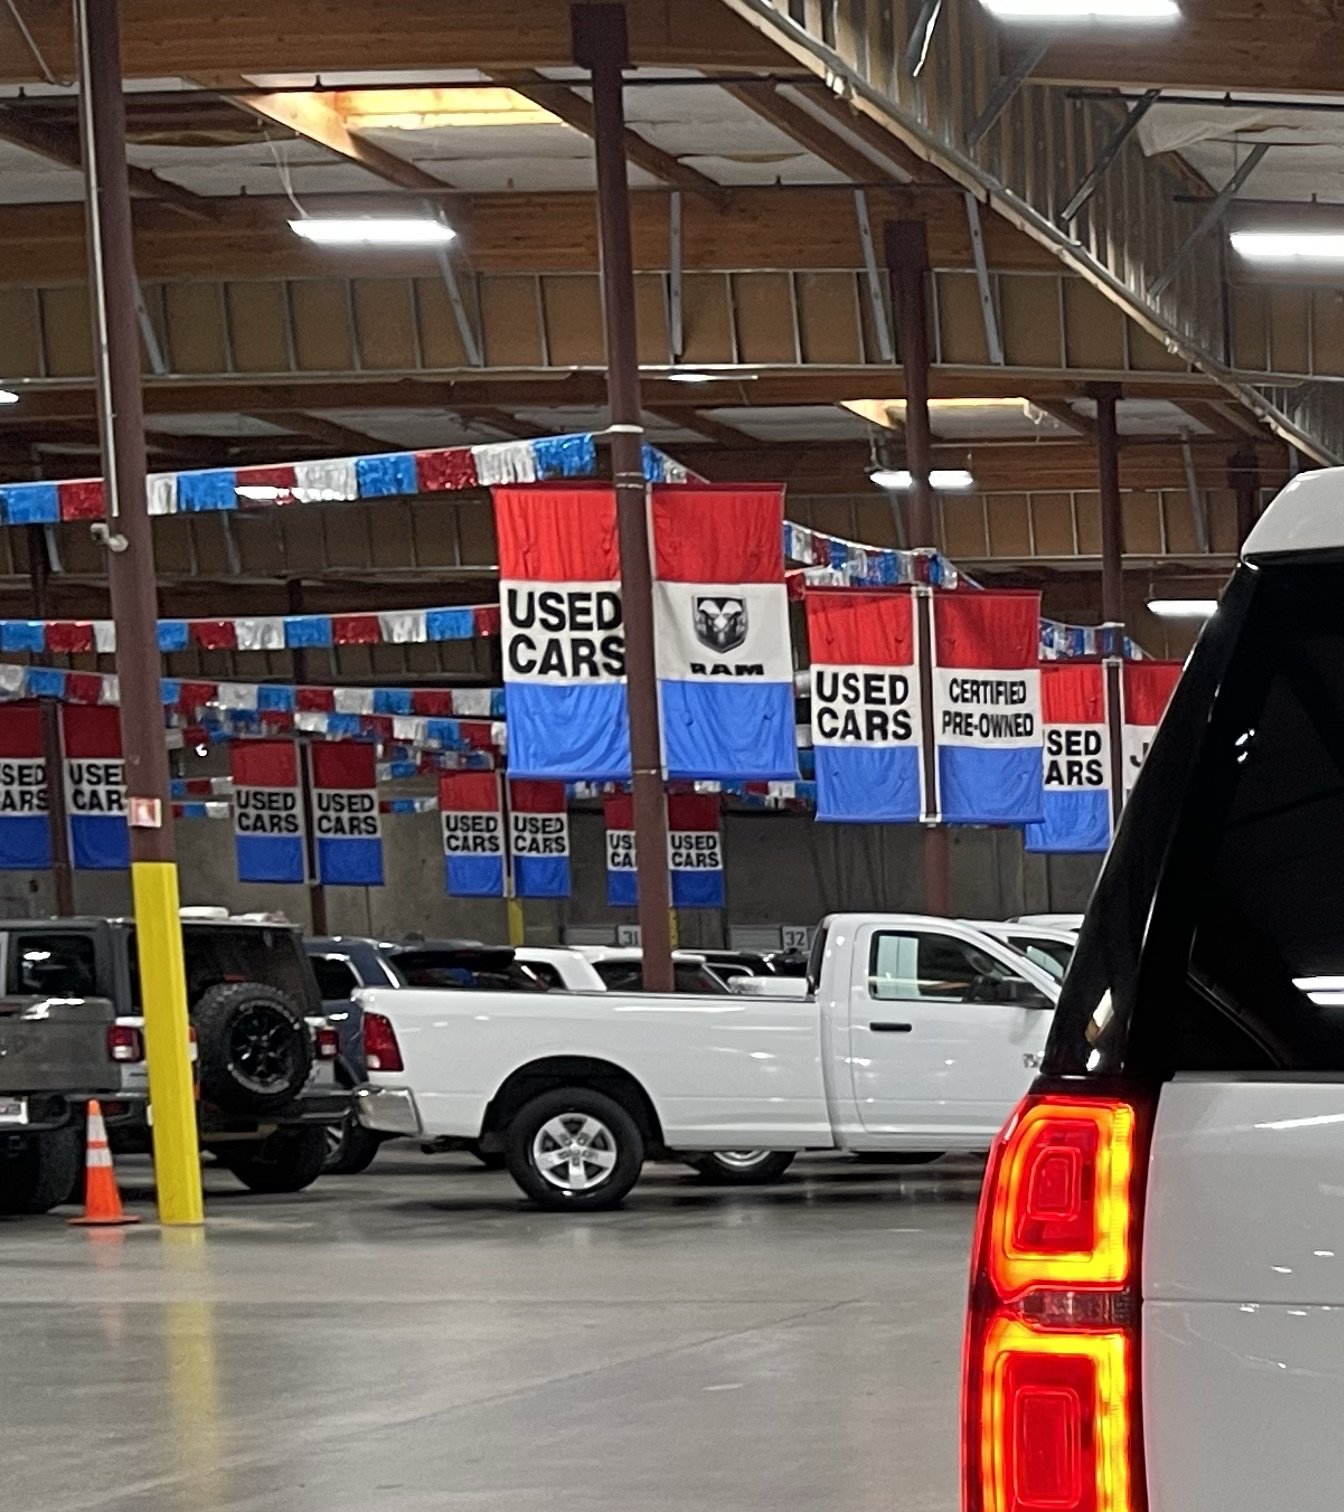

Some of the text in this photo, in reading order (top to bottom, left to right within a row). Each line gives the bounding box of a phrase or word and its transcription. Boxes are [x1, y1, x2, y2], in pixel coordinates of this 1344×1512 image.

[507, 588, 623, 632] USED
[508, 633, 627, 678] CARS
[690, 662, 765, 677] RAM
[816, 670, 909, 706] USED
[949, 677, 1027, 706] CERTIFIED
[816, 706, 913, 741] CARS
[942, 709, 1034, 739] PRE-OWNED
[1043, 729, 1102, 756] SED
[0, 763, 46, 787] SED
[1043, 758, 1104, 786] ARS
[0, 789, 49, 812] ARS
[72, 789, 126, 812] CAR
[236, 790, 297, 812] USED
[317, 792, 375, 813] USED
[237, 812, 299, 834] CARS
[317, 814, 378, 835] CARS
[445, 814, 498, 833] USED
[514, 815, 565, 834] USED
[446, 834, 500, 852] CARS
[514, 834, 566, 854] CARS
[609, 833, 633, 851] US
[670, 834, 718, 851] USED
[610, 851, 634, 868] CA
[671, 851, 720, 868] CARS
